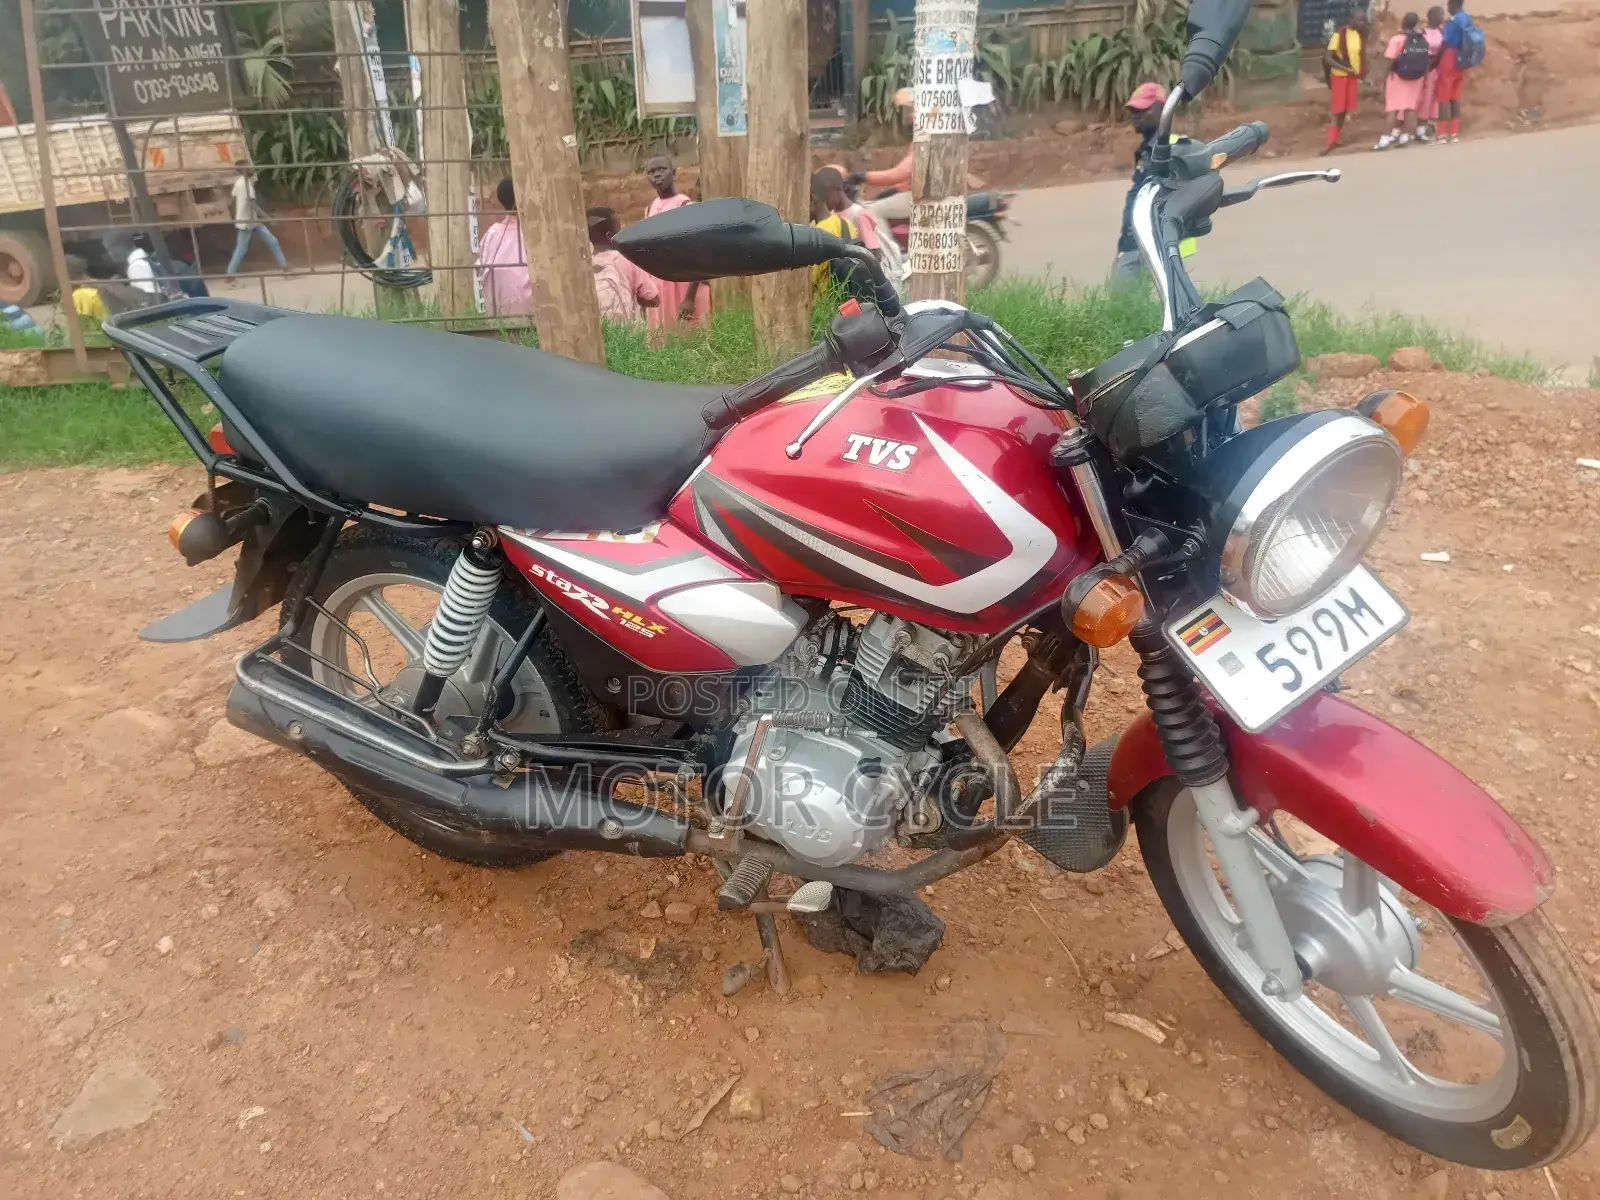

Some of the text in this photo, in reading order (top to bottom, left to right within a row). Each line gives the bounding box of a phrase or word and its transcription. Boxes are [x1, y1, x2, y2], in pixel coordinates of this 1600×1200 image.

[93, 0, 219, 39] PARKING
[110, 42, 225, 73] DAY AND NIGHT
[133, 72, 219, 104] 0703-930548
[842, 433, 919, 471] TVS
[611, 606, 668, 635] HLX
[619, 618, 657, 638] 125
[1256, 586, 1384, 692] 599M
